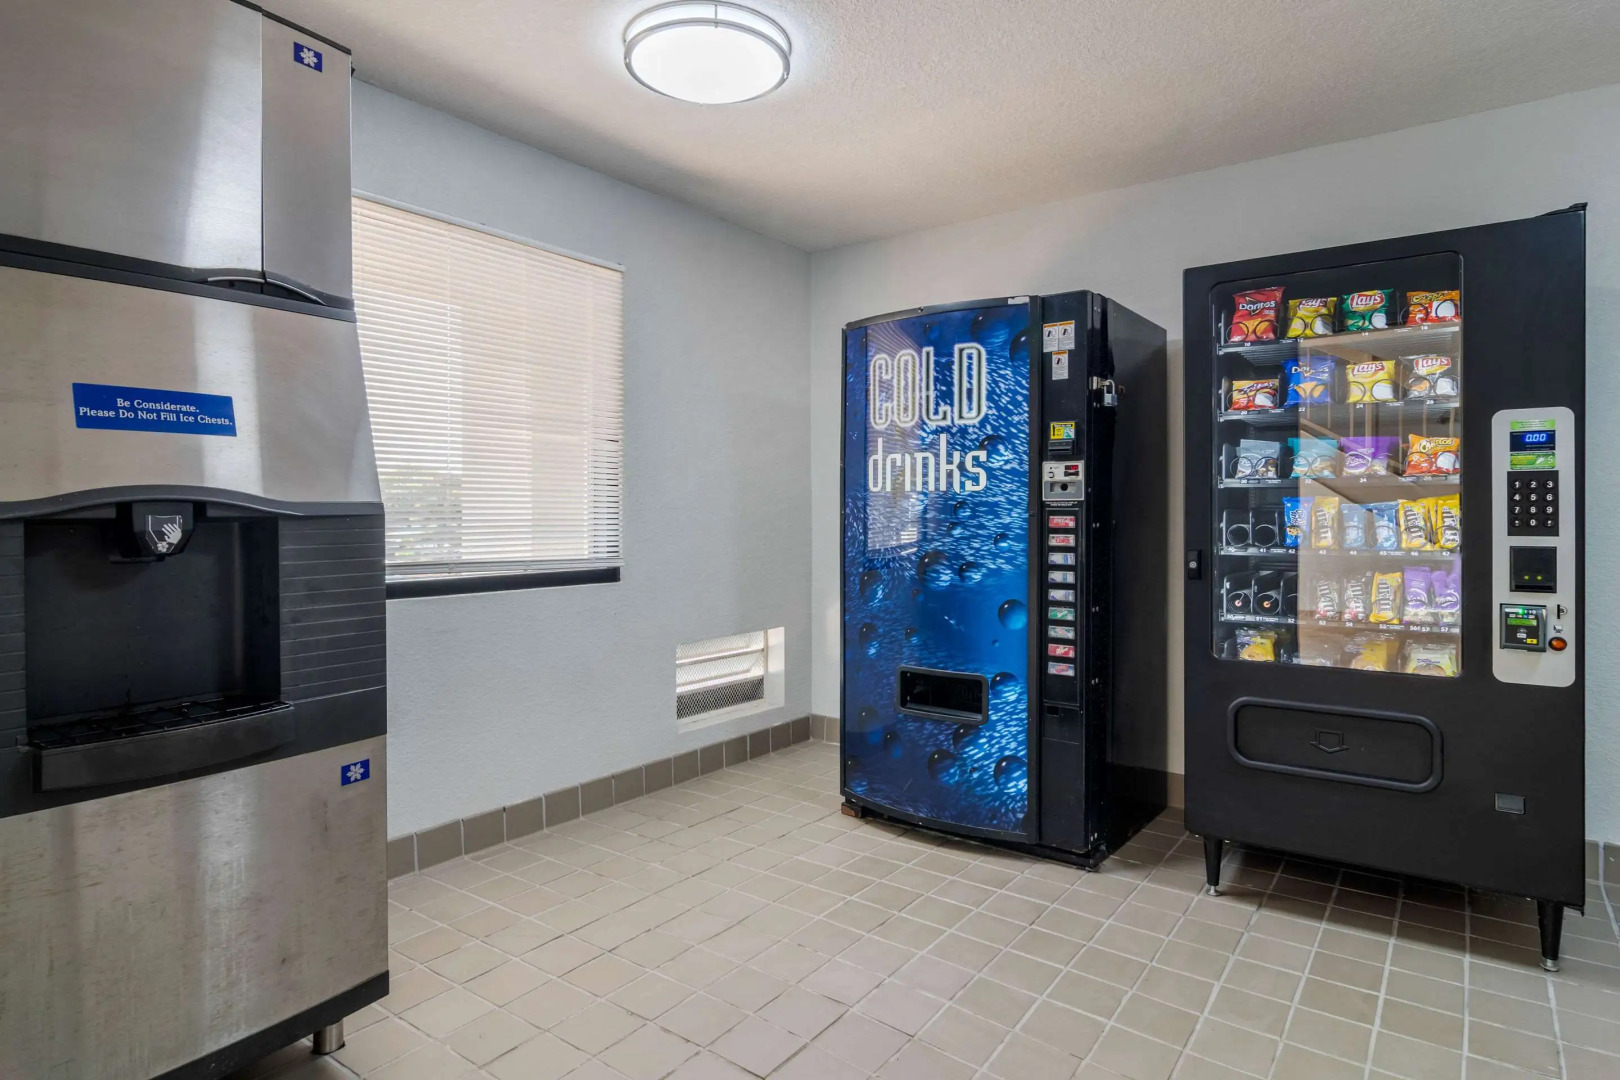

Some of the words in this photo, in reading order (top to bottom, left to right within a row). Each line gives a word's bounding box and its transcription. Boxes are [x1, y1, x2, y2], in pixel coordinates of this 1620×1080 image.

[1239, 300, 1276, 312] Doritos
[870, 342, 987, 429] COLD
[117, 398, 130, 407] Be
[134, 400, 199, 413] Considerate.
[79, 407, 116, 418] Please
[119, 410, 134, 419] Do
[138, 411, 158, 420] Not
[160, 413, 177, 422] Fill
[180, 414, 195, 423] Ice
[197, 415, 233, 425] Chests.
[868, 433, 988, 494] drinks
